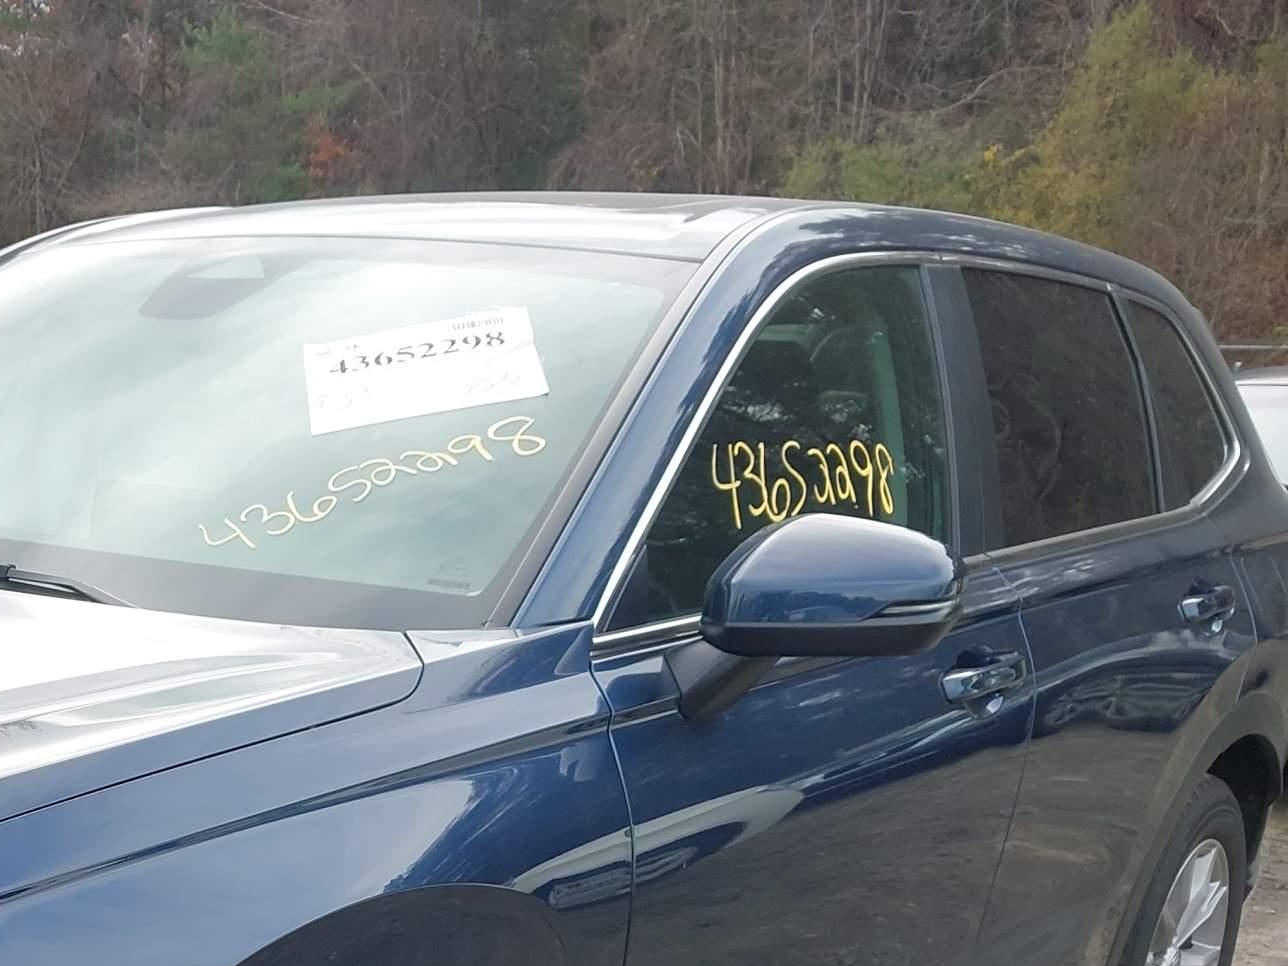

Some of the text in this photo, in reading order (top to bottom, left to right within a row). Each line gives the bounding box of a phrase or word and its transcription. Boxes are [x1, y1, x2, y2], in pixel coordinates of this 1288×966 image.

[328, 330, 506, 375] 43652298
[198, 415, 546, 549] 43652298
[711, 439, 895, 530] 43652298
